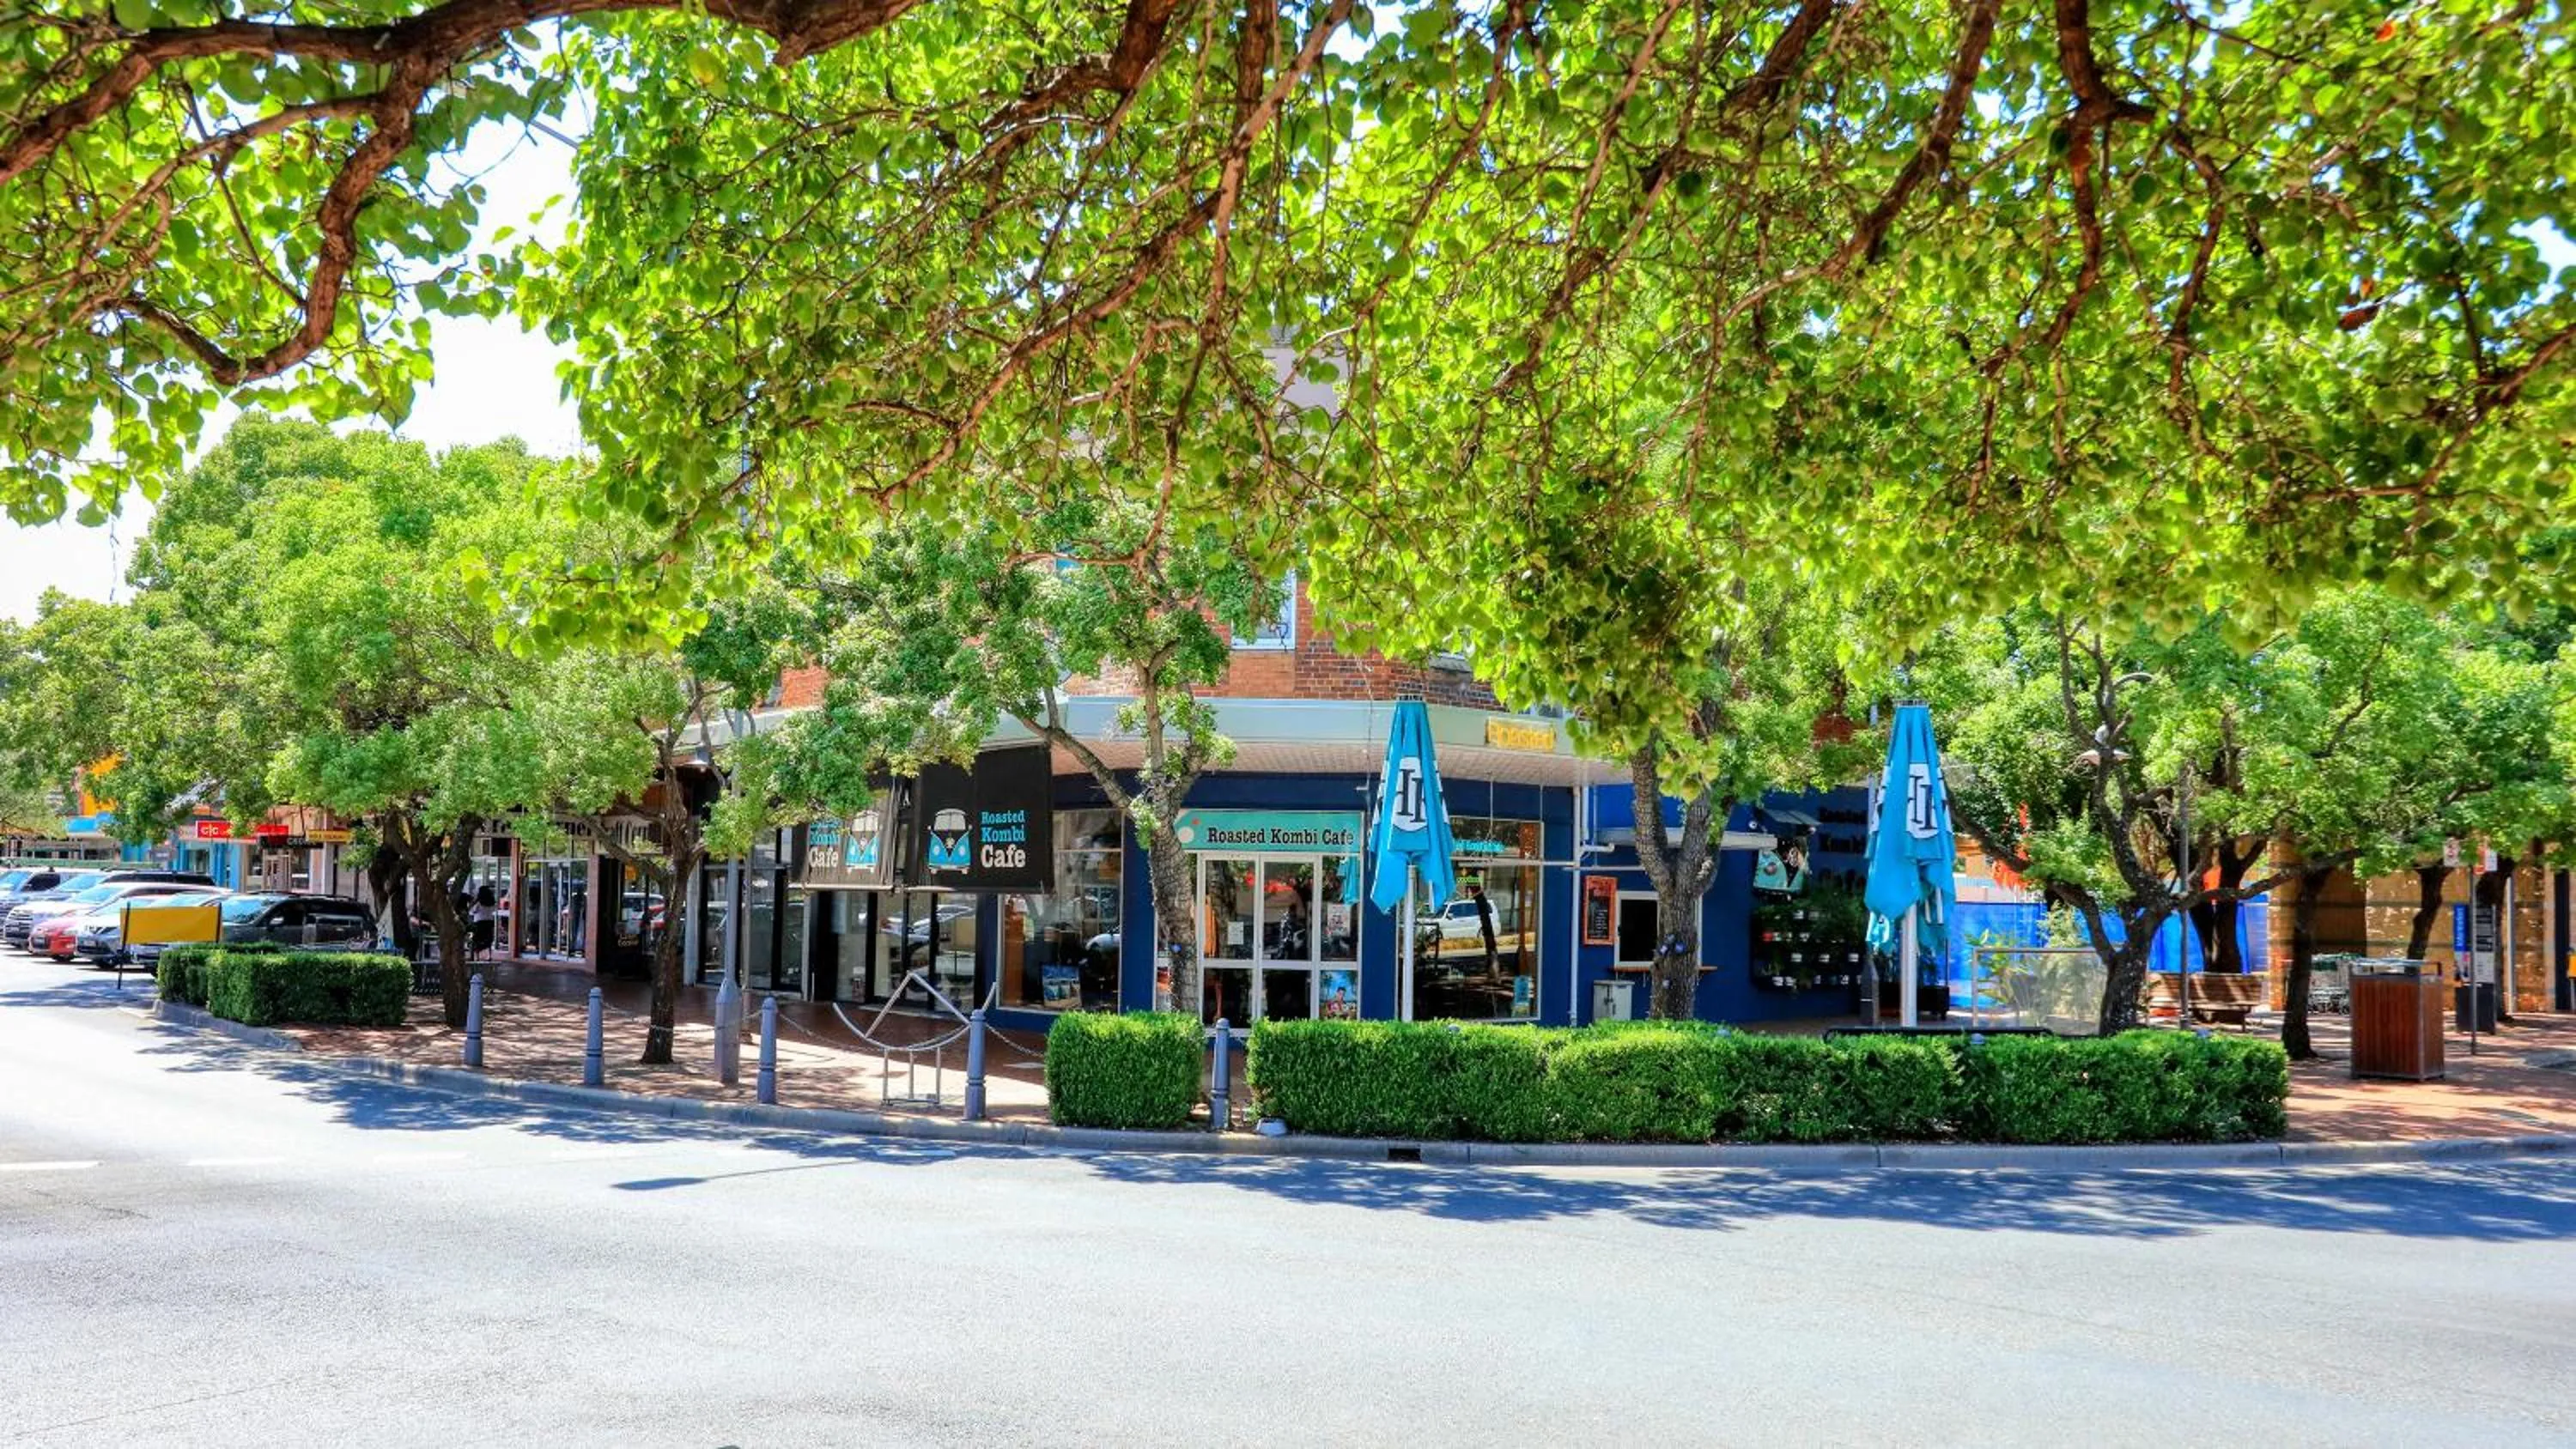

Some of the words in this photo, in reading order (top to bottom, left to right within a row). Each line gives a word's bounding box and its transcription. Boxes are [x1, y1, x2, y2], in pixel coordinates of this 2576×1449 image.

[981, 809, 1026, 824] Roasted
[981, 824, 1026, 843] Kombi
[1206, 827, 1266, 844] Roasted
[1270, 828, 1318, 845] Kombi
[1321, 828, 1354, 846] Cafe
[809, 846, 839, 868] Cafe
[981, 844, 1026, 868] Cafe
